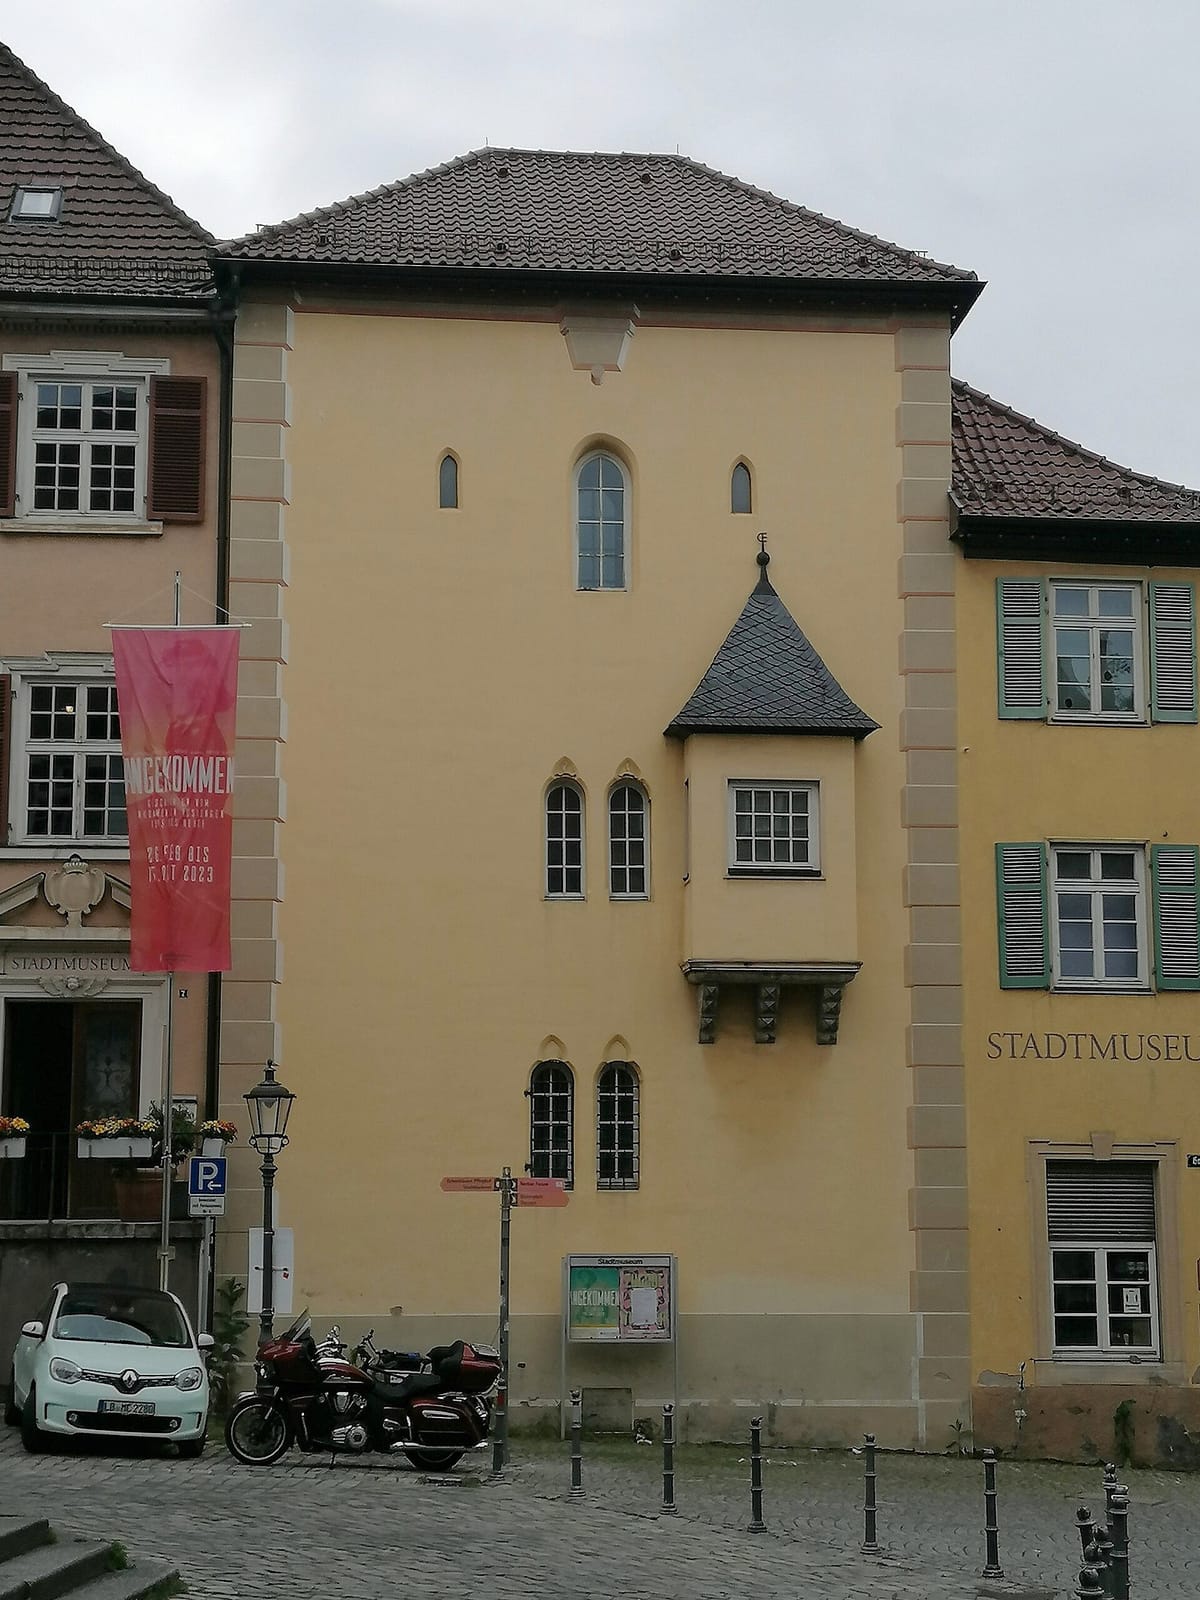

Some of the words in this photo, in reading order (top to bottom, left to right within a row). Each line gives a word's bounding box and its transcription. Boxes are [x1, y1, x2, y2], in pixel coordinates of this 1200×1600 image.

[183, 865, 214, 883] 2023
[986, 1032, 1200, 1062] STADTMUSEU
[198, 1162, 219, 1190] P
